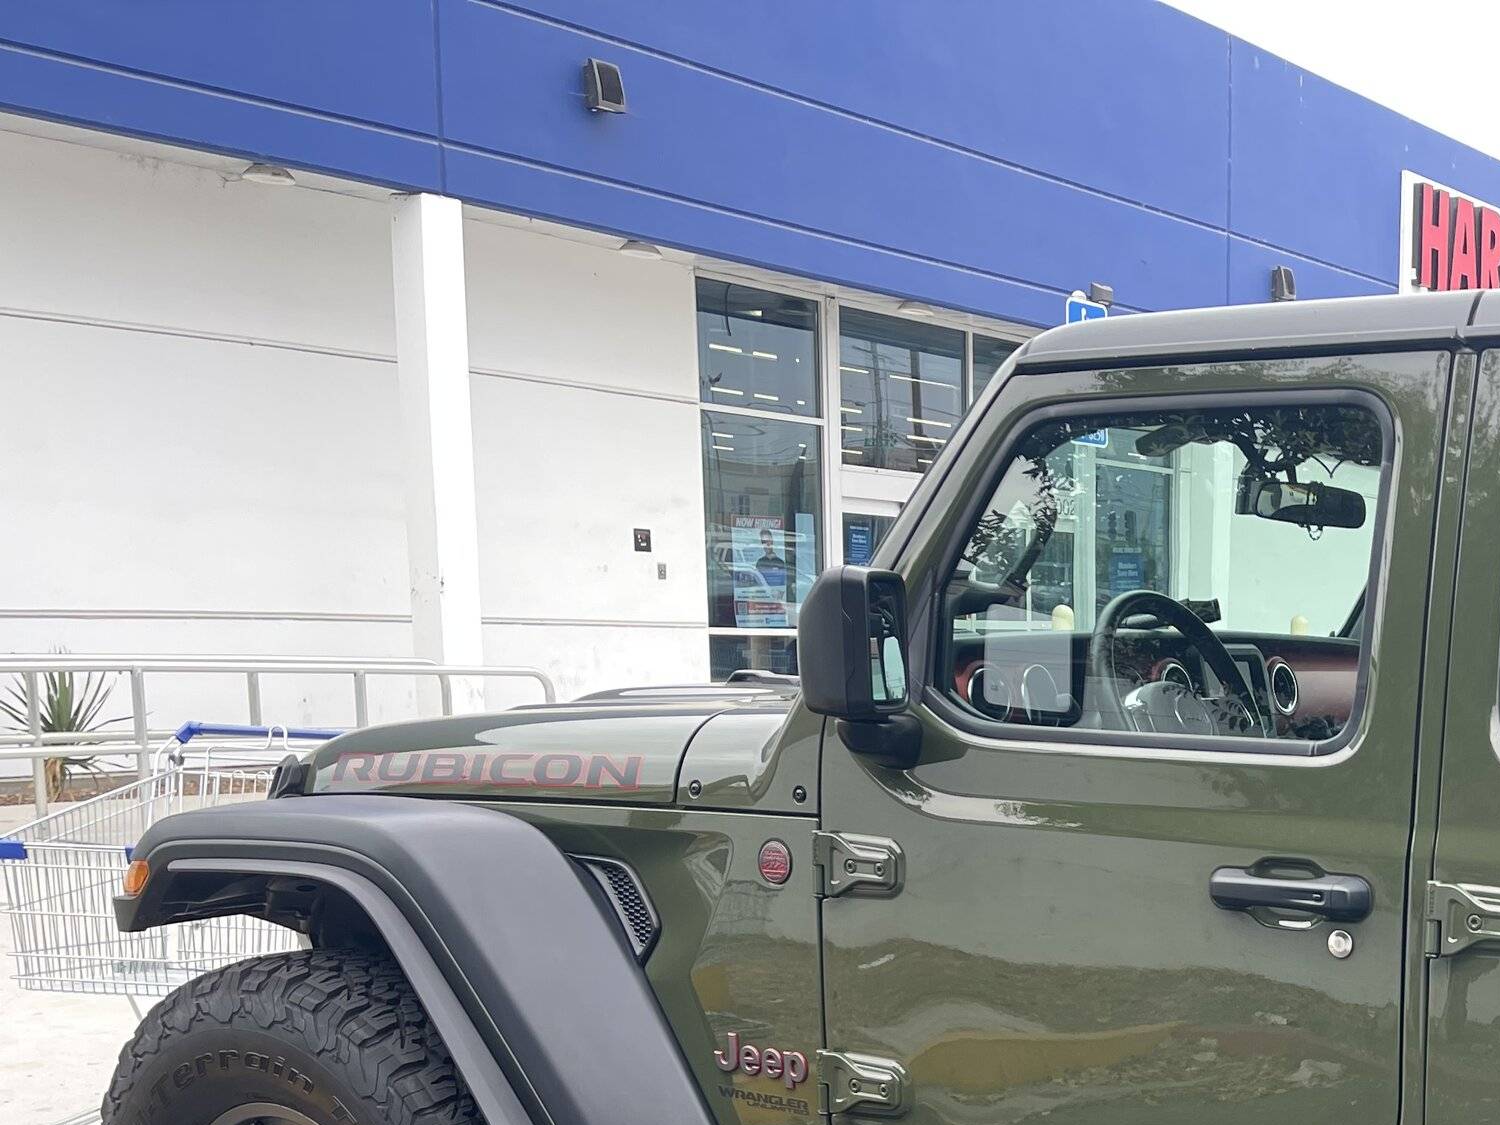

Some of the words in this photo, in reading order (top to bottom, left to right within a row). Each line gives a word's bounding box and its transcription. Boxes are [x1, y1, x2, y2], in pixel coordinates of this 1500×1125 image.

[735, 517, 754, 528] NOW
[754, 518, 782, 529] HIRING!
[330, 751, 646, 791] RUBICON
[713, 1031, 810, 1091] Jeep
[717, 1085, 809, 1110] WRANGLER
[746, 1100, 810, 1116] UNLIMITED
